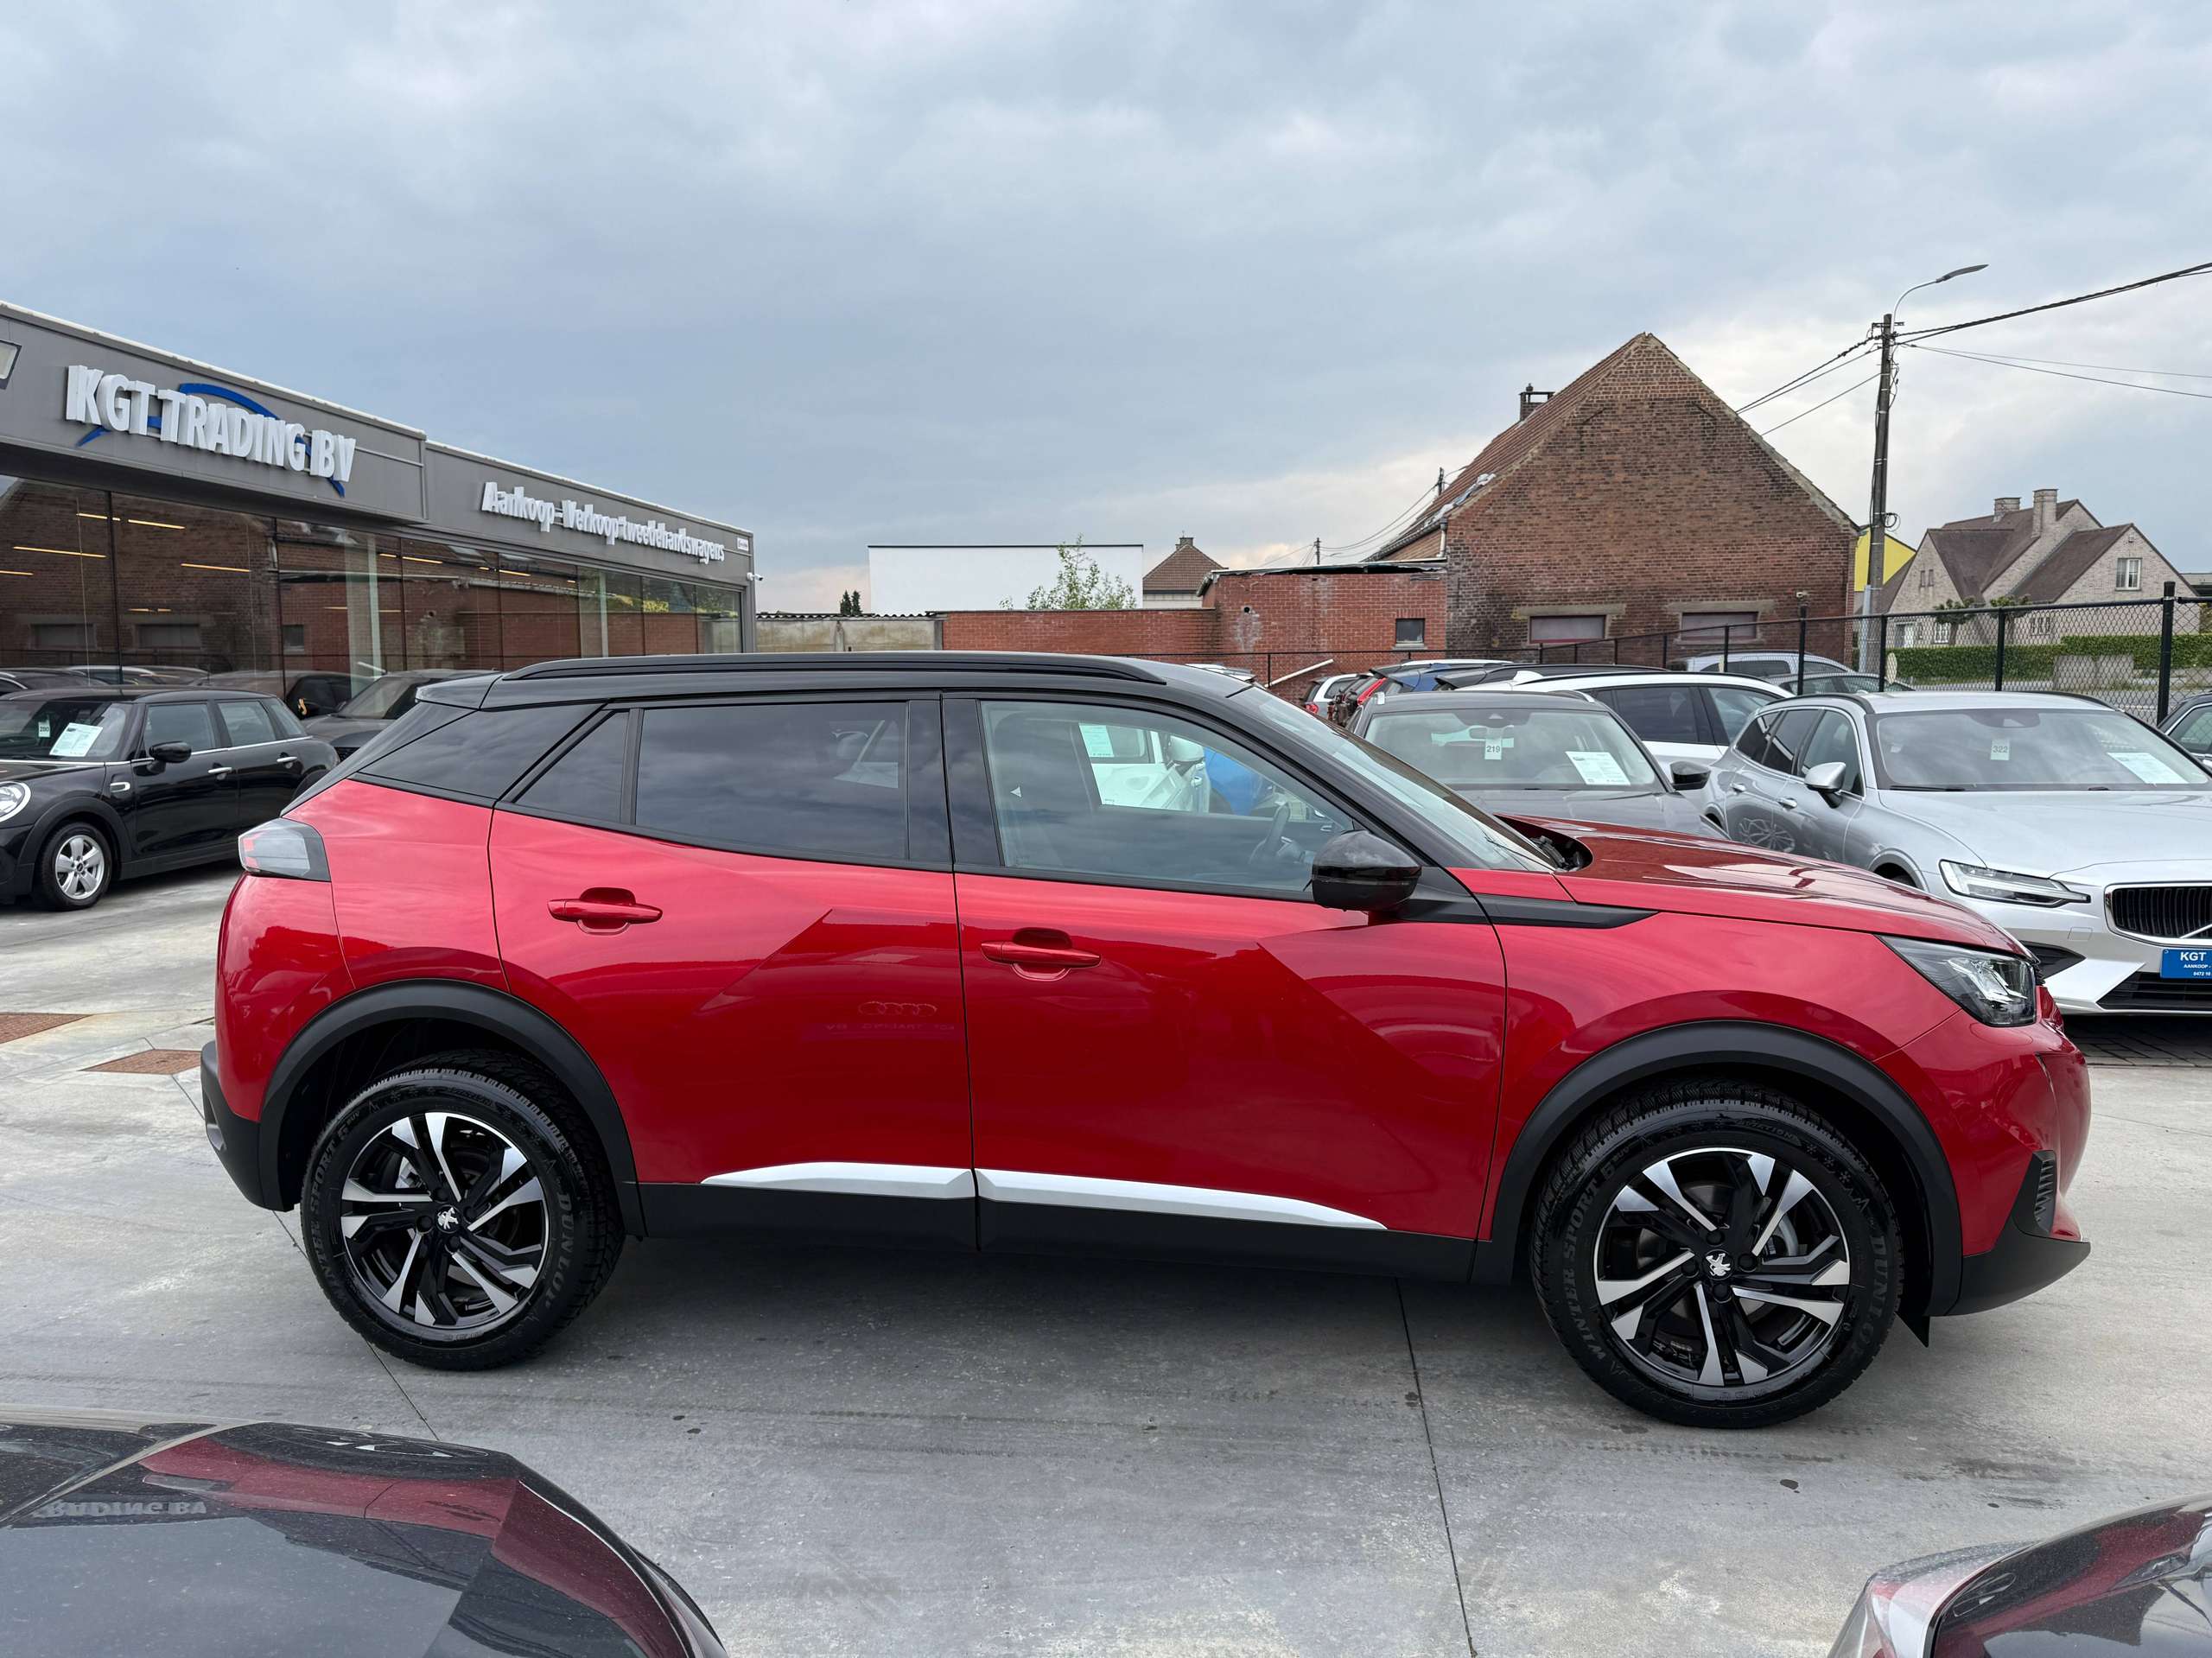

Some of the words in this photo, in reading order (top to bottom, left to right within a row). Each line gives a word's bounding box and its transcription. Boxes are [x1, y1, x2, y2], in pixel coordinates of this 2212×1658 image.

[66, 365, 156, 435] KGT
[158, 389, 306, 472] TRADING
[310, 429, 357, 483] BV
[2180, 951, 2207, 962] KGT
[544, 1191, 575, 1308] DUNLOP
[1562, 1178, 1603, 1262] SPORT
[1561, 1266, 1607, 1360] WINTER
